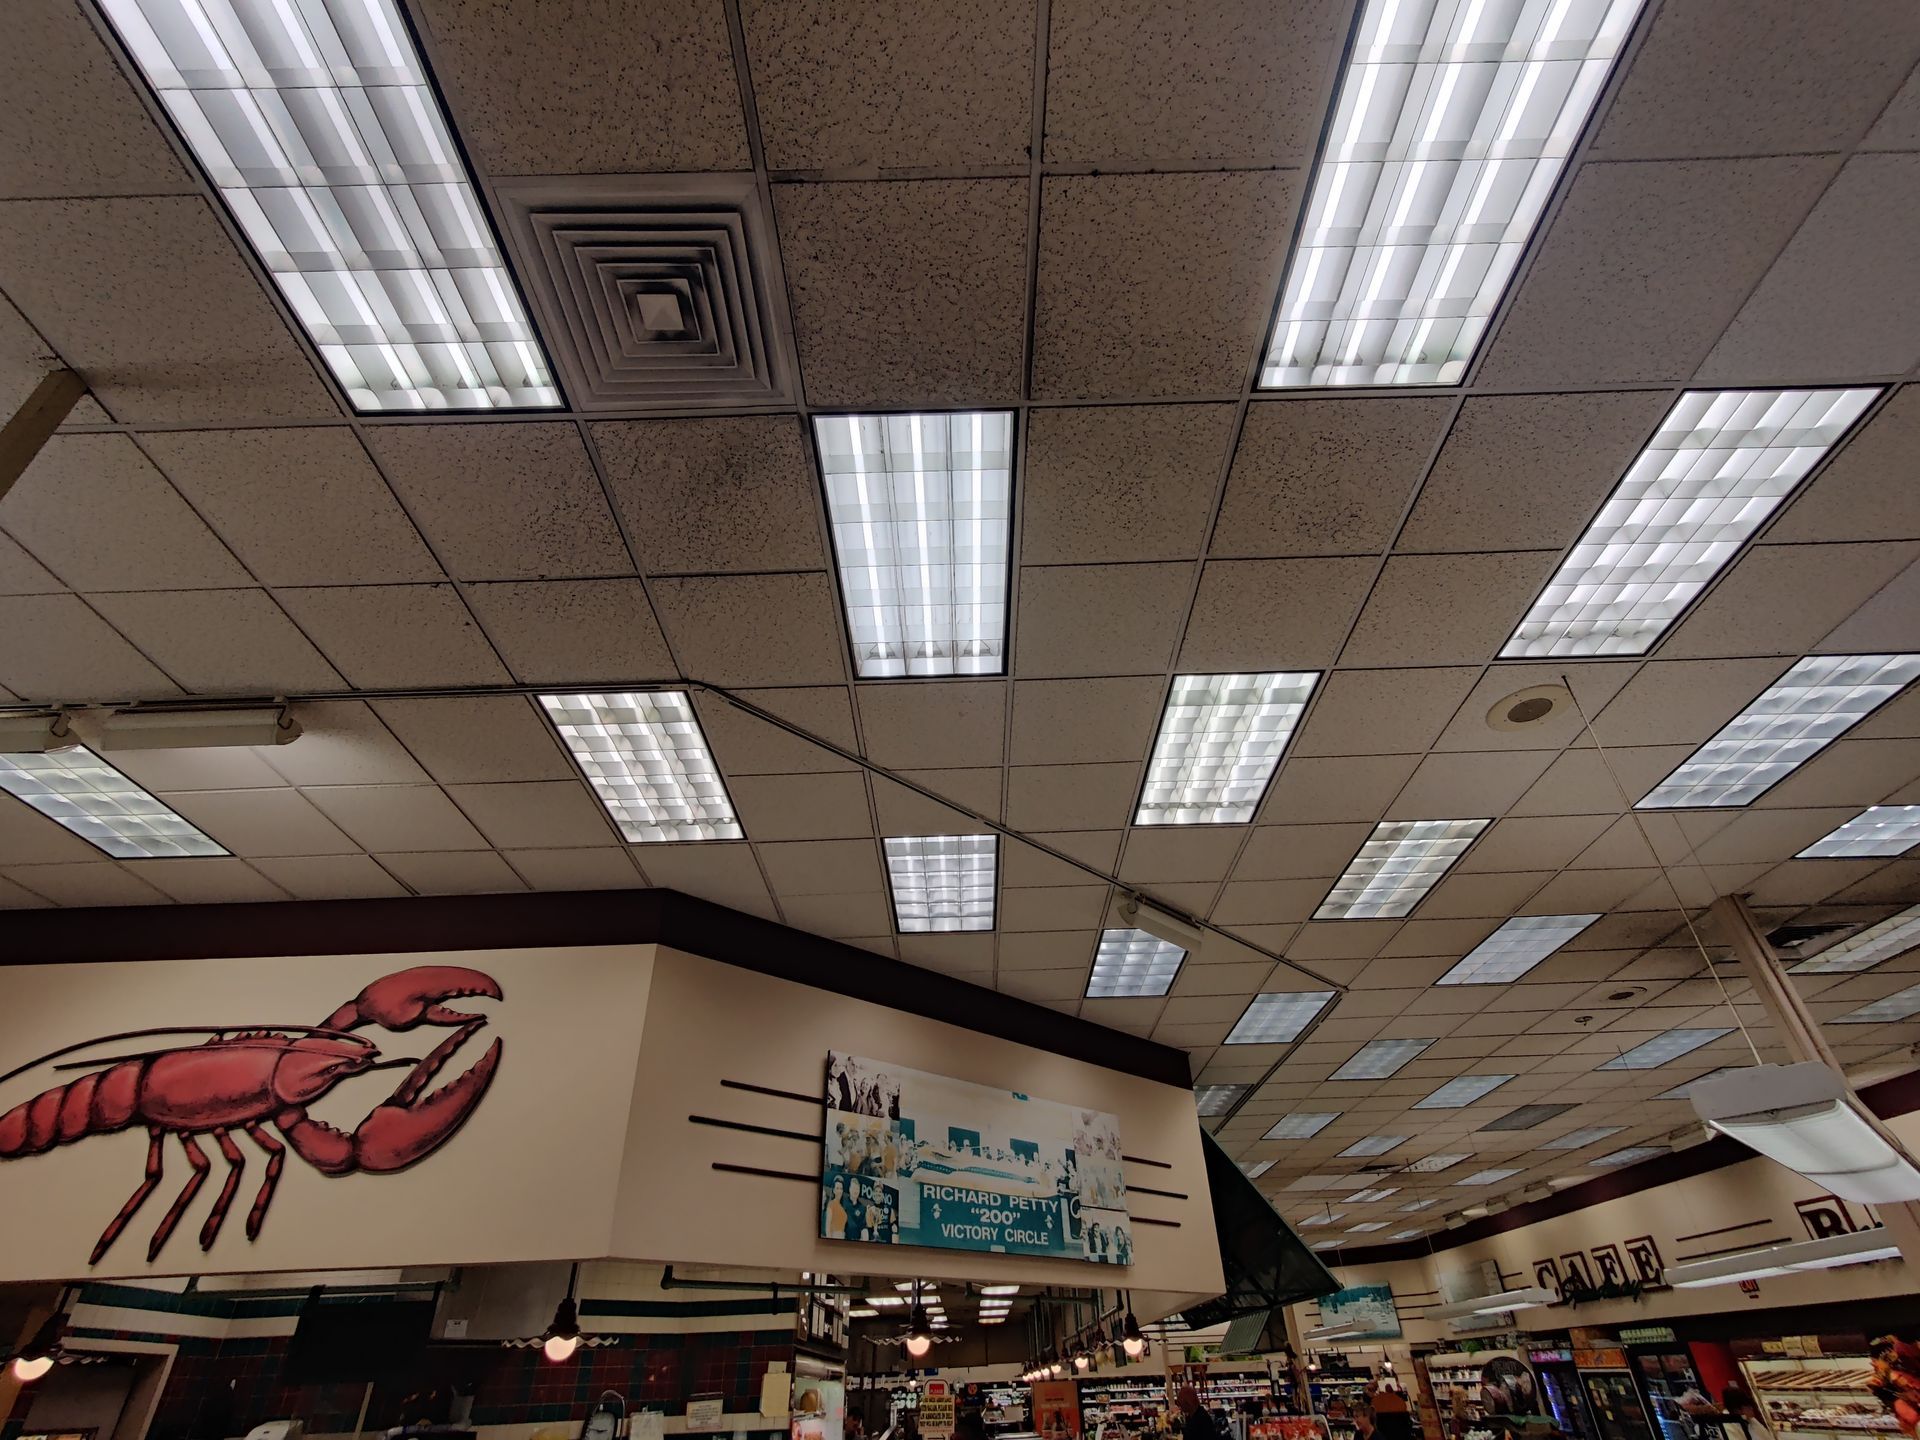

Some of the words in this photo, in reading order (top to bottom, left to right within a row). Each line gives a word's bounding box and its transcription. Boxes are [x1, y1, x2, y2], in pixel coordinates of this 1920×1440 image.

[923, 1184, 1001, 1206] RICHARD
[1009, 1196, 1059, 1213] PETTY
[941, 1223, 998, 1240] VICTORY
[1004, 1228, 1049, 1245] CIRCLE
[1534, 1240, 1664, 1302] CAFE
